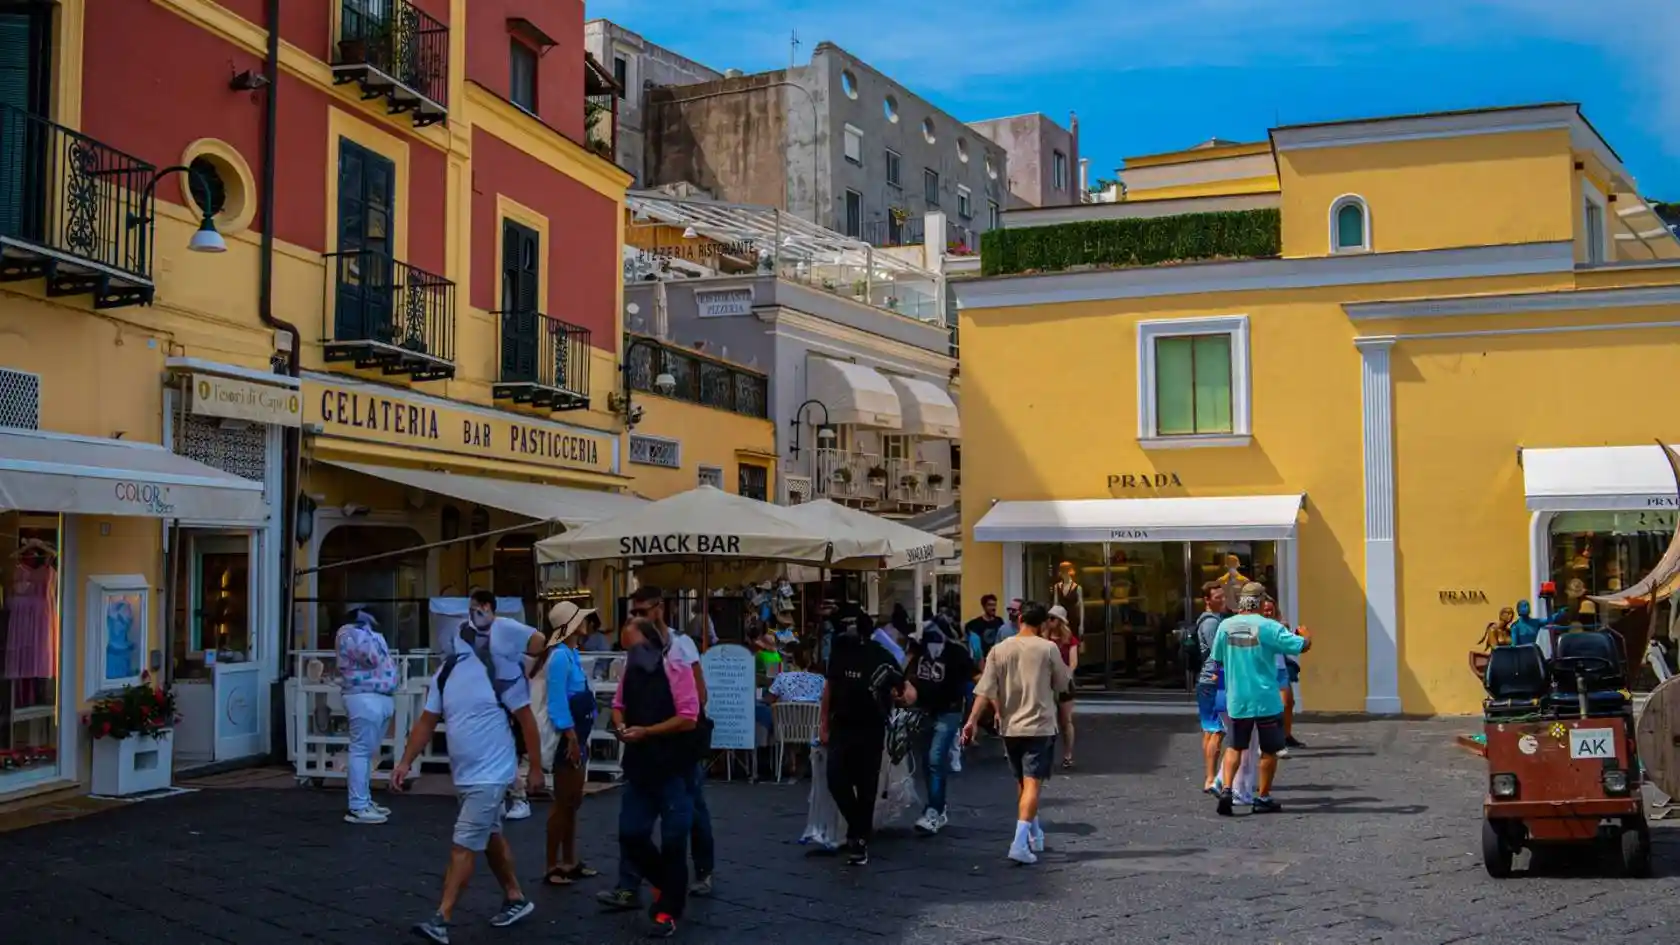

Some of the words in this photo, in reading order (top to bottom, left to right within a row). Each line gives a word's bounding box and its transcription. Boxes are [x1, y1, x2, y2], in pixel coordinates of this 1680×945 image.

[639, 245, 694, 260] PIZZERIA
[698, 240, 755, 258] RISTORANTE
[707, 303, 745, 315] PIZZERIA
[321, 389, 439, 439] GELATERIA
[463, 420, 492, 448] BAR
[511, 425, 598, 464] PASTICCERIA
[1107, 472, 1182, 488] PRADA
[1111, 530, 1149, 539] PRADA
[620, 534, 690, 554] SNACK
[697, 534, 740, 553] BAR
[923, 544, 934, 560] BAR
[1439, 590, 1488, 601] PRADA
[1578, 738, 1608, 756] AK
